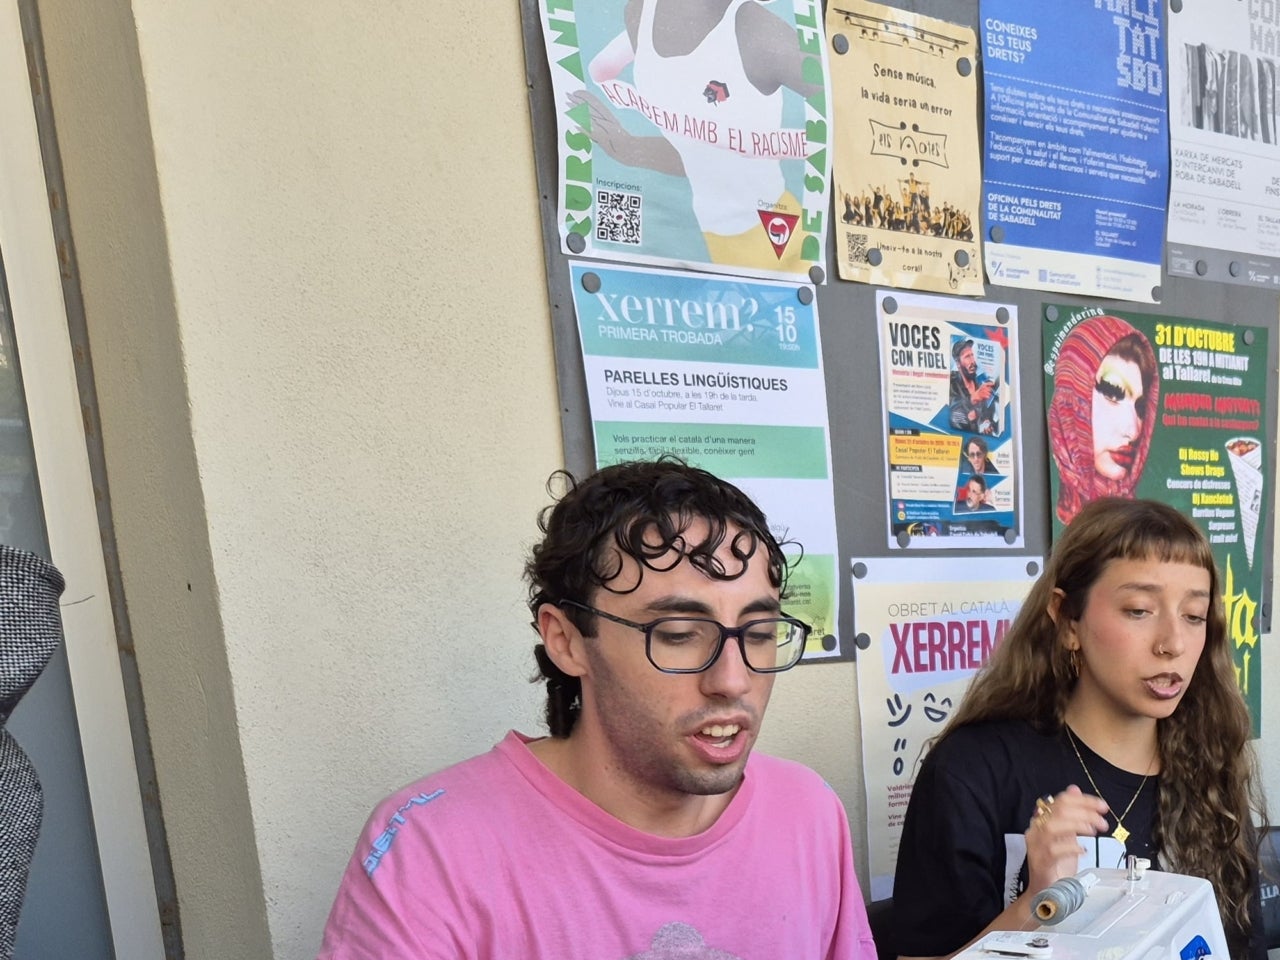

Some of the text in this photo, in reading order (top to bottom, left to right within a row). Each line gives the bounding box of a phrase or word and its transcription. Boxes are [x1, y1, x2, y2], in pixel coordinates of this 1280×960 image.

[985, 18, 1038, 40] CONEIXES
[986, 32, 1032, 51] ELS TEUS
[987, 46, 1025, 64] DRETS?
[873, 63, 903, 80] Sense
[861, 86, 952, 117] la vida seria un error
[601, 82, 808, 158] ACABEM AMB EL RACISME
[794, 0, 827, 262] DE SABADEL
[1175, 148, 1243, 169] XARXA DE MERCATS
[1175, 170, 1242, 191] ROBA DE SABADELL
[1226, 168, 1236, 179] DE
[1271, 176, 1280, 186] DE
[596, 177, 643, 192] Inscripcions:
[1265, 186, 1280, 197] FINS
[987, 193, 1062, 211] OFICINA PELS DRETS
[988, 202, 1061, 220] DE LA COMUNALITAT
[988, 212, 1037, 226] DE SABADELL
[774, 305, 795, 324] 15
[599, 325, 723, 346] PRIMERA TROBADA
[776, 324, 797, 342] 10
[889, 322, 941, 351] VOCES
[1155, 324, 1235, 353] 31 D'OCTUBRE
[891, 349, 948, 370] CON FIDEL
[1159, 347, 1172, 364] DE
[1173, 348, 1191, 365] LES
[1208, 351, 1215, 368] A
[604, 369, 788, 391] PARELLES LINGÜÍSTIQUES
[1162, 365, 1174, 380] al
[1174, 365, 1211, 383] Tallaret
[606, 386, 629, 397] Dijous
[632, 388, 641, 397] 15
[691, 391, 702, 399] les
[704, 391, 718, 400] 19h
[719, 392, 729, 400] de
[731, 392, 737, 401] la
[607, 399, 624, 408] Vine
[626, 399, 632, 408] al
[634, 399, 656, 409] Casal
[658, 400, 687, 411] Popular
[689, 402, 696, 410] El
[613, 434, 629, 443] Vols
[632, 435, 667, 445] practicar
[669, 435, 676, 443] el
[704, 435, 726, 444] d'una
[728, 437, 756, 445] manera
[738, 448, 755, 457] gent
[1180, 463, 1225, 477] Shows Drags
[941, 602, 958, 615] AL
[960, 598, 1010, 614] CATALÀ
